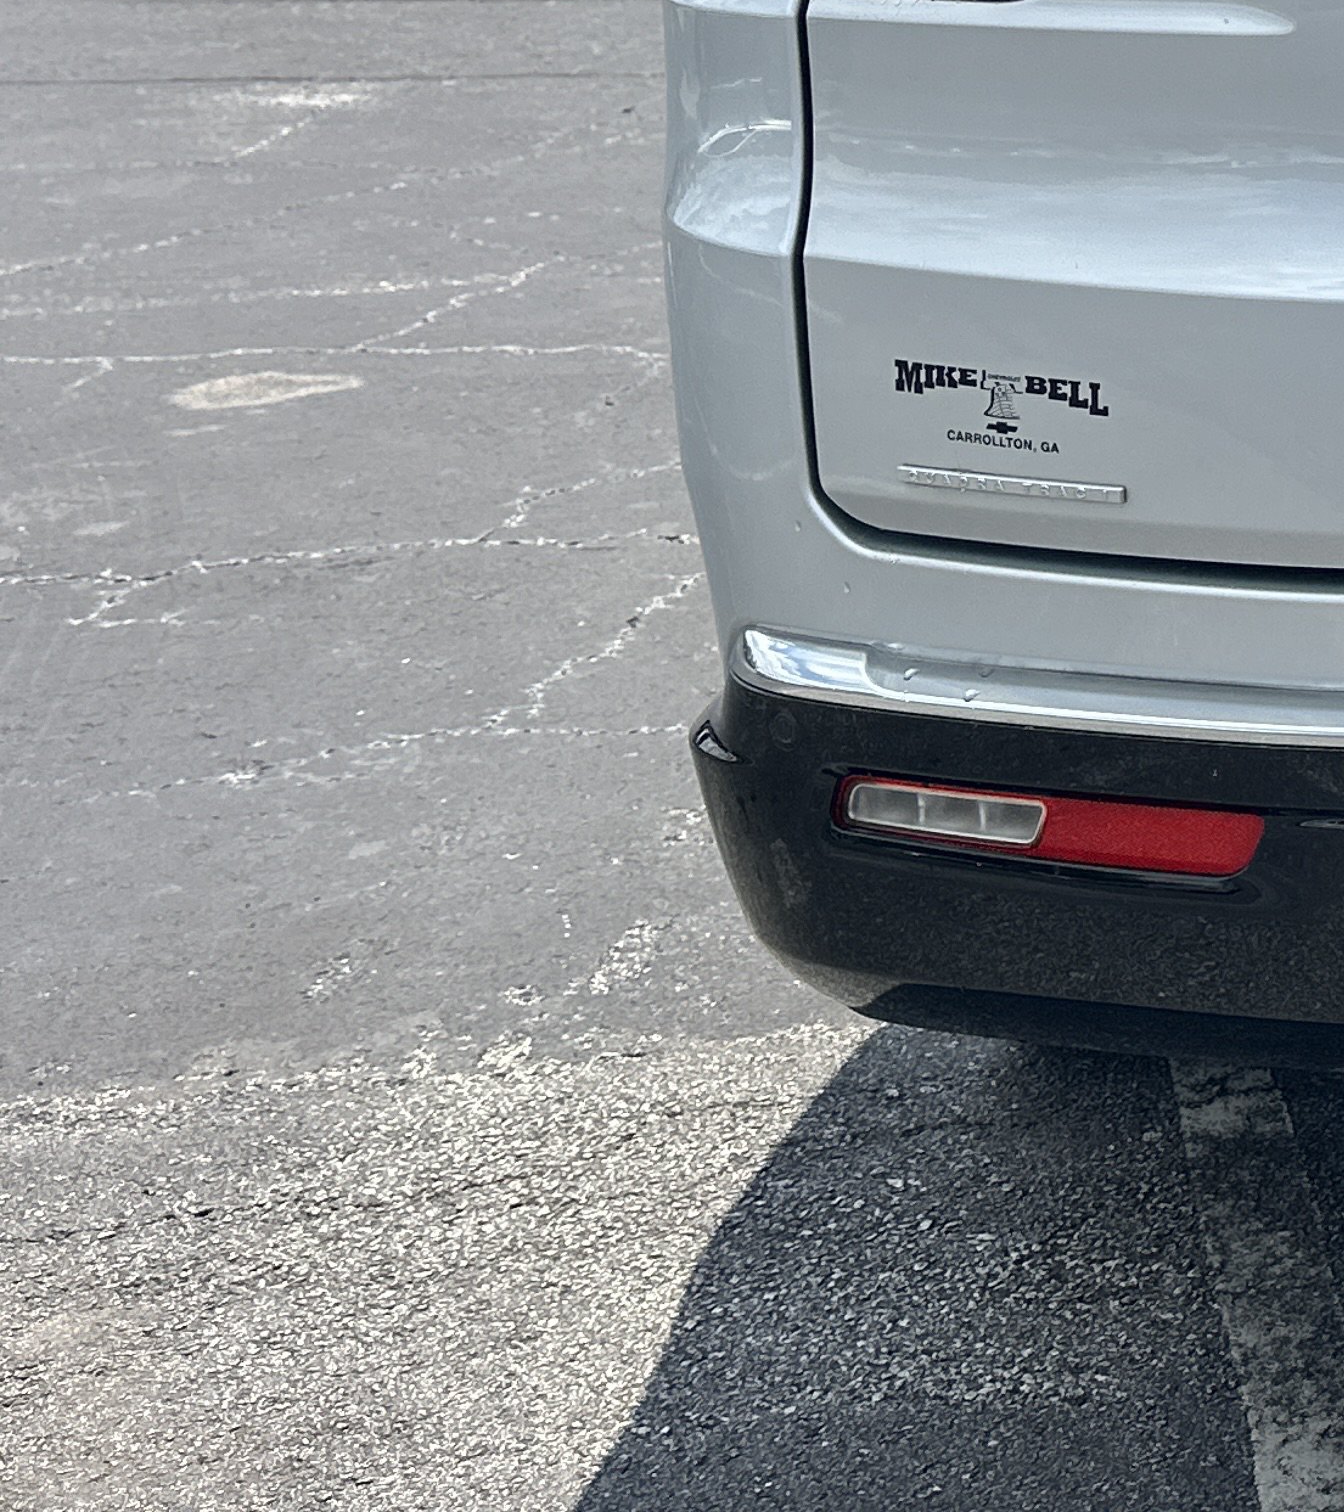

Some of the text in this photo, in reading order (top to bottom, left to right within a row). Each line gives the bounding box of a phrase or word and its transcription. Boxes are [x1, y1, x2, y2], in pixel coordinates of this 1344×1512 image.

[894, 359, 1109, 417] MIKE BELL
[1041, 440, 1060, 454] GA
